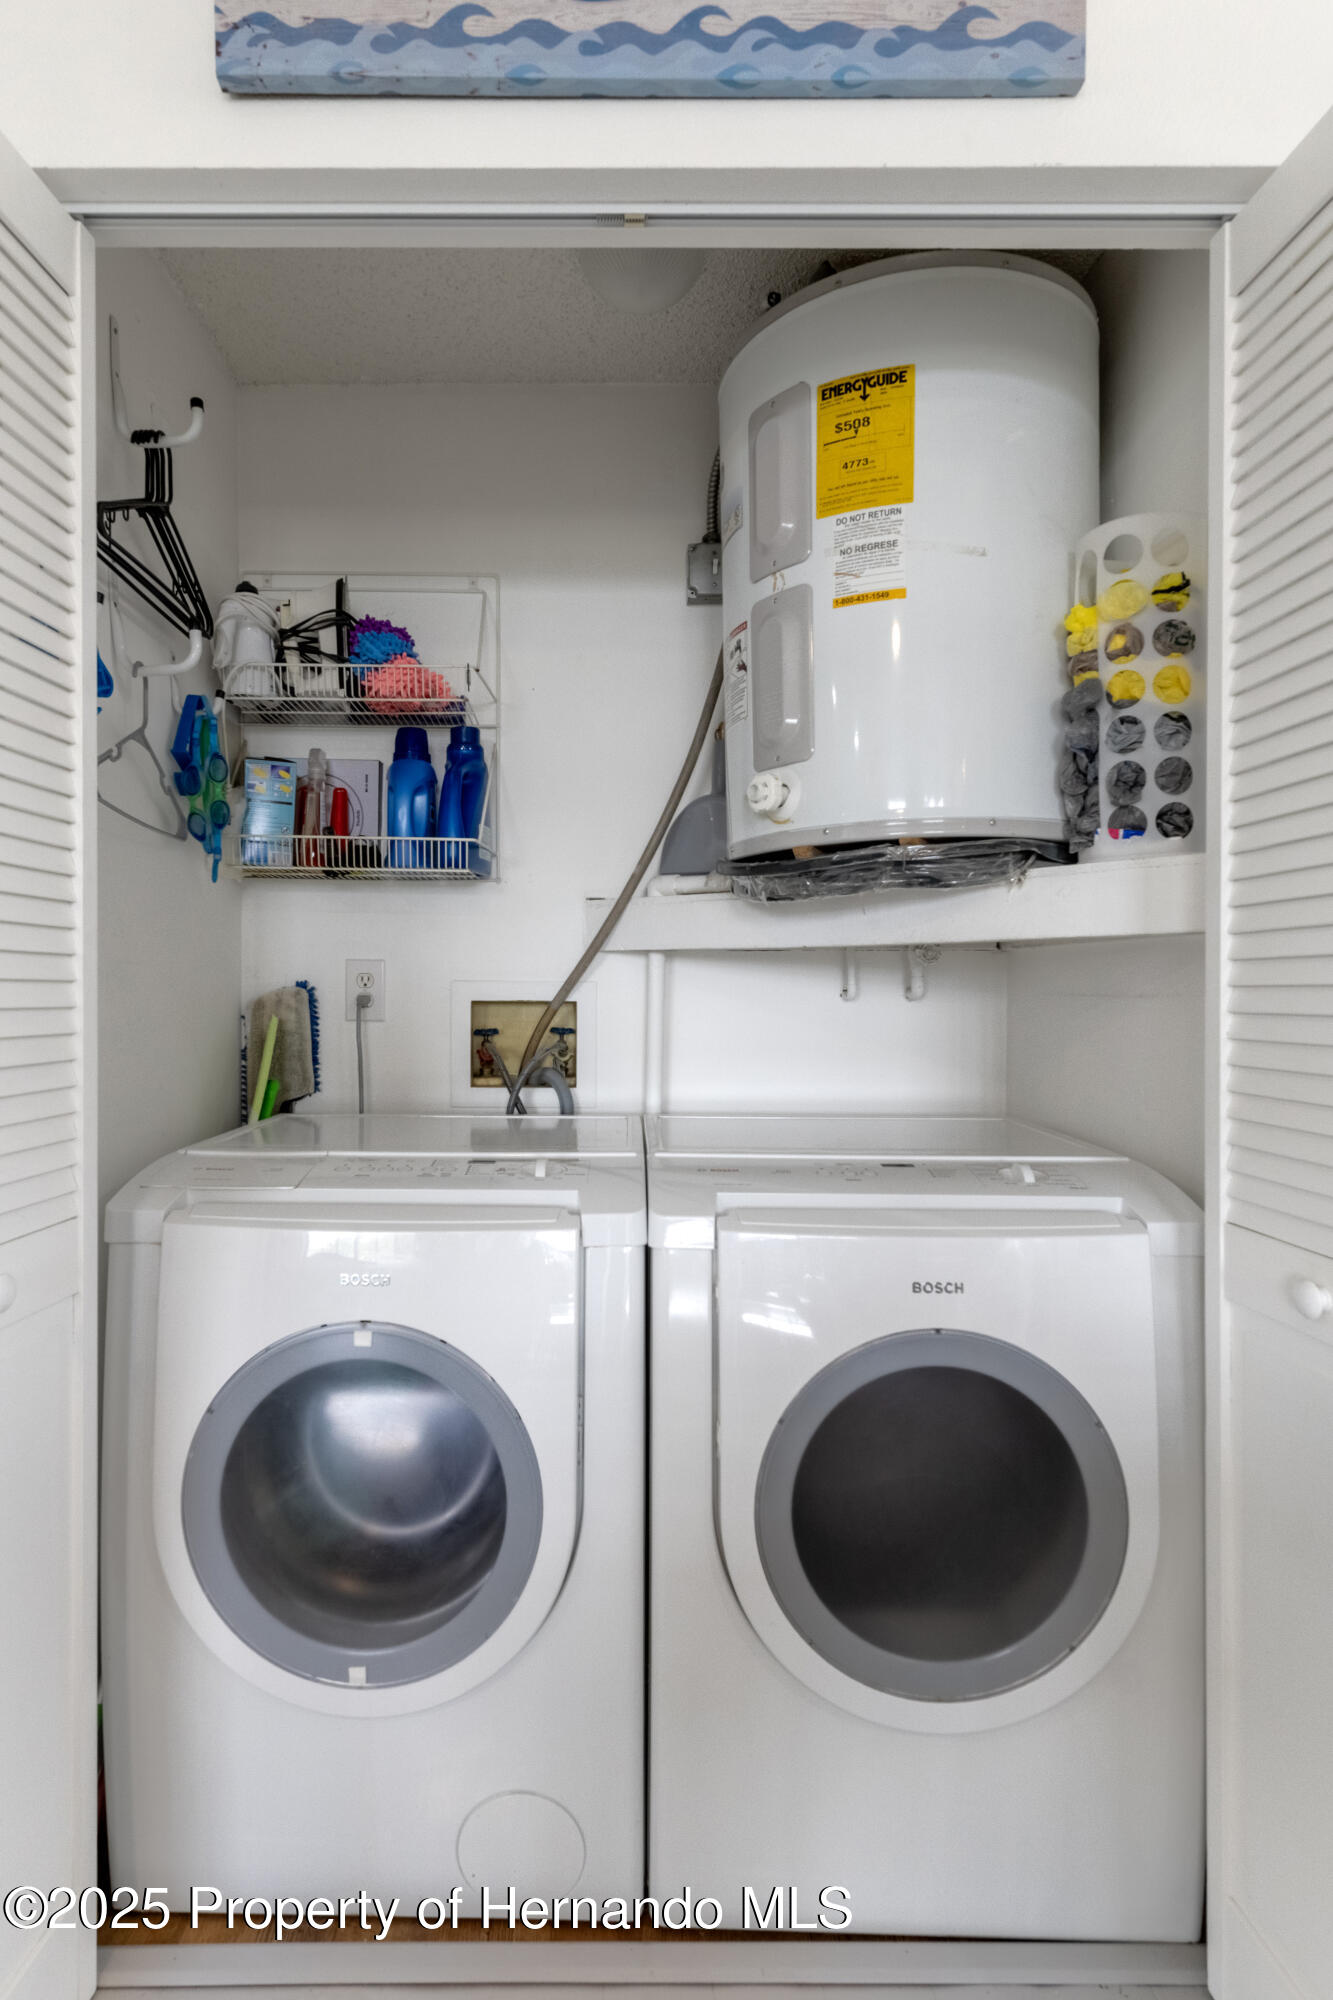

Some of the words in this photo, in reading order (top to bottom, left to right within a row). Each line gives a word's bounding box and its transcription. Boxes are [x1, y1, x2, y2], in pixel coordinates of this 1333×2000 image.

[821, 370, 908, 402] ENERGYGUIDE
[842, 457, 869, 470] 4773
[835, 516, 848, 527] DO
[849, 512, 867, 523] NOT
[868, 507, 902, 520] RETURN
[840, 547, 853, 557] NO
[854, 539, 899, 554] REGRESE
[339, 1273, 391, 1287] BOSCH
[911, 1281, 965, 1295] BOSCH
